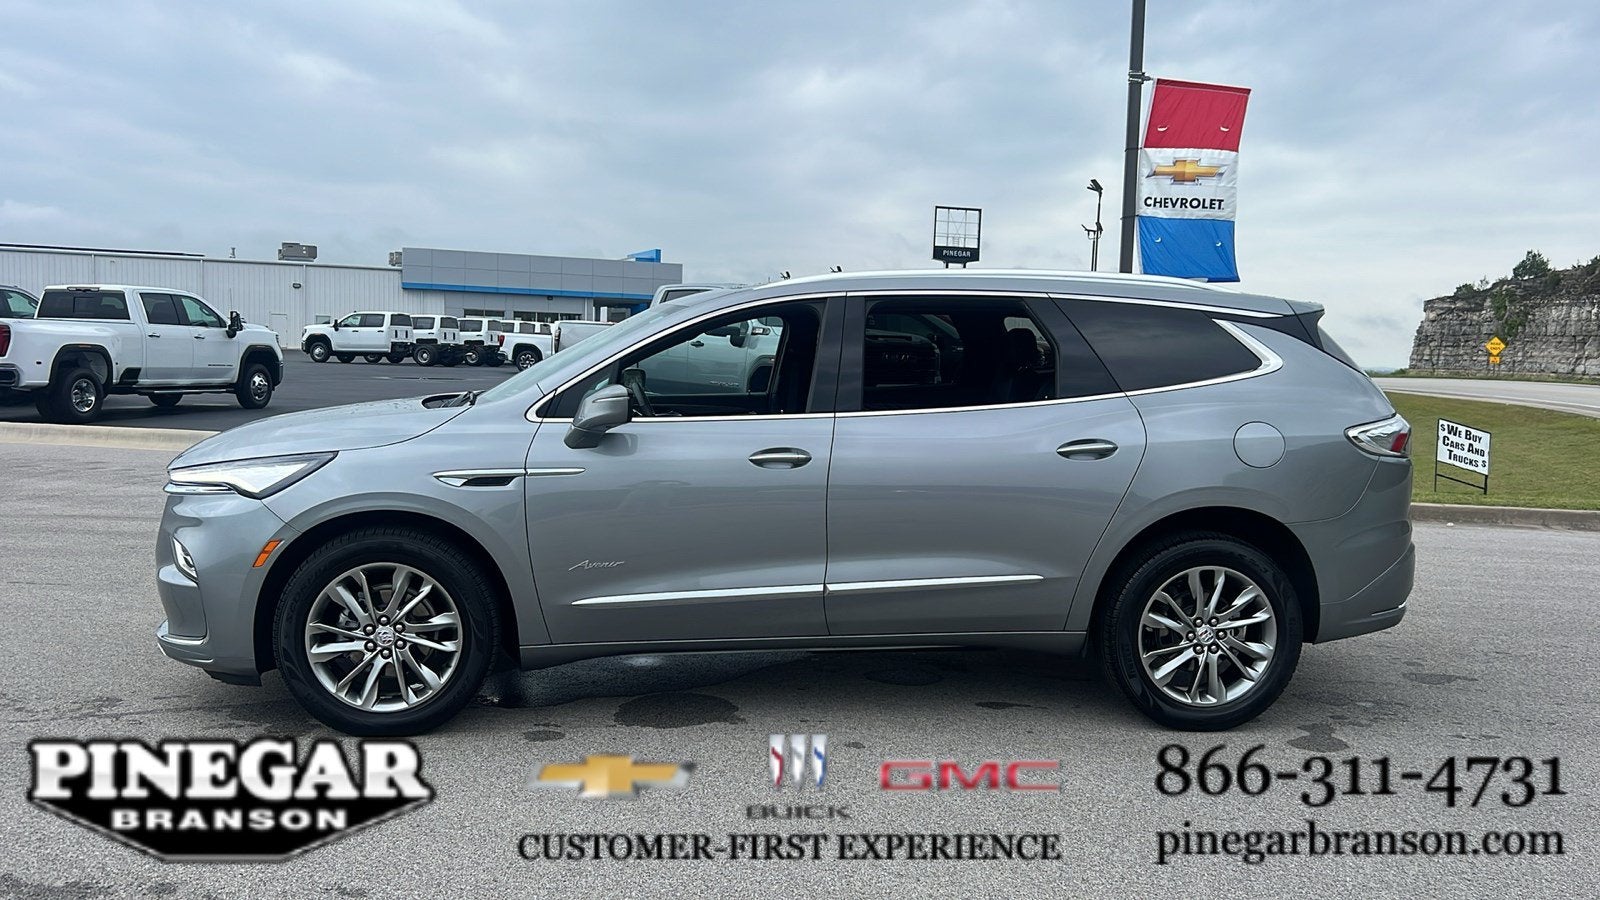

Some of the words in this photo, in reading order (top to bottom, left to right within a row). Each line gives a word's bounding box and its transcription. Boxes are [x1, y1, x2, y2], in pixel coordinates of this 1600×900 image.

[1144, 196, 1224, 210] CHEVROLET
[942, 249, 971, 258] PINEGAR
[1465, 429, 1482, 443] BUY
[1442, 435, 1465, 451] CARS
[1467, 442, 1485, 457] AND
[1447, 449, 1479, 467] TRUCKS
